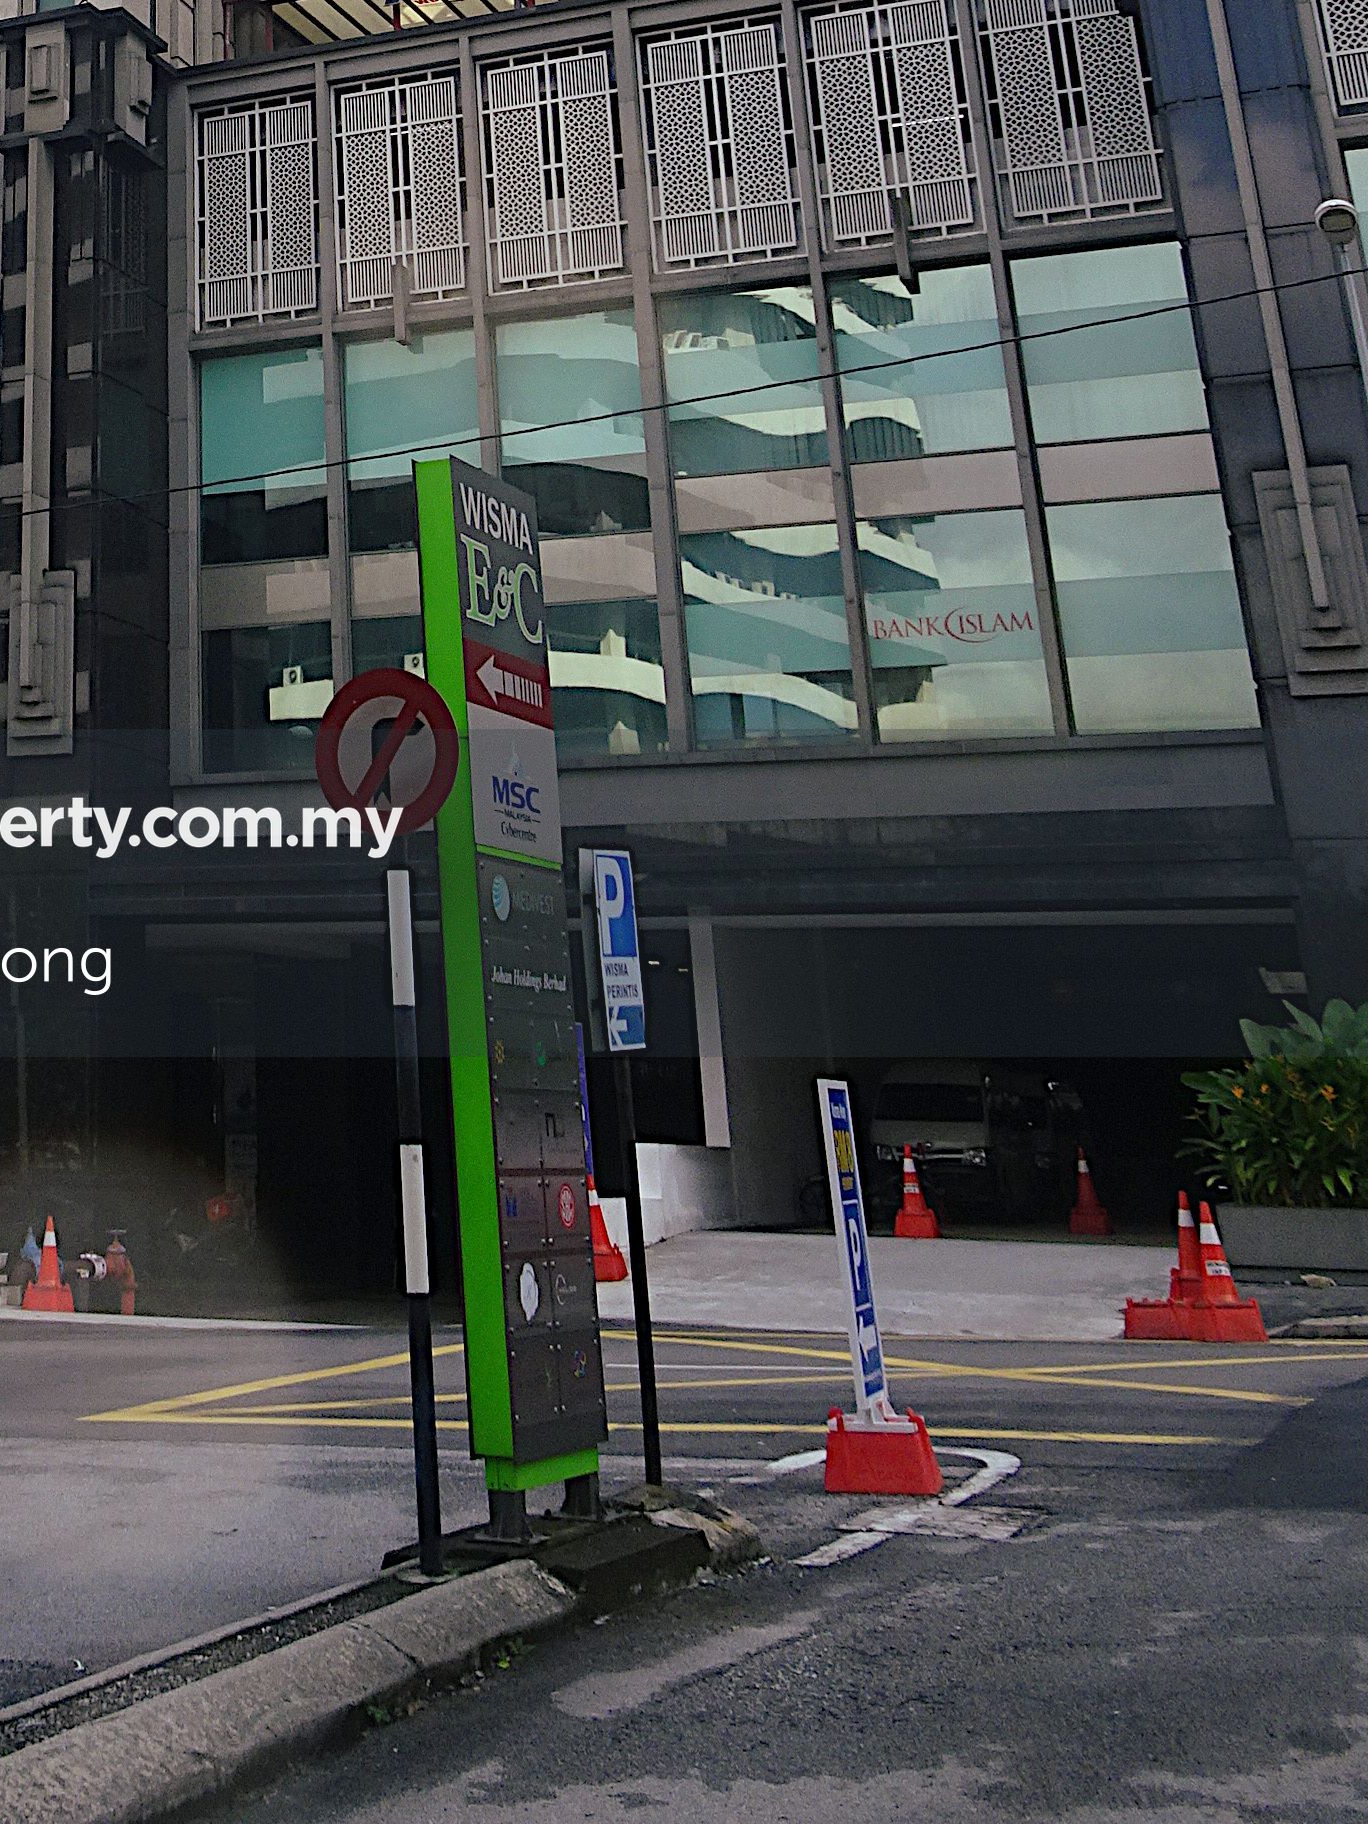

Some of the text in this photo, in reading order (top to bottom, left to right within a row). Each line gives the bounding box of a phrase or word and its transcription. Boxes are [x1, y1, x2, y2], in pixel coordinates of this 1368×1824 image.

[460, 483, 533, 555] WISMA
[460, 533, 543, 644] E&C
[873, 611, 1034, 639] BANK ISLAM
[492, 776, 541, 814] MSC
[596, 857, 624, 955] P
[513, 969, 543, 993] Holdings
[543, 972, 567, 992] Berhad
[604, 962, 630, 976] WISMA
[606, 984, 640, 1000] PERINTIS
